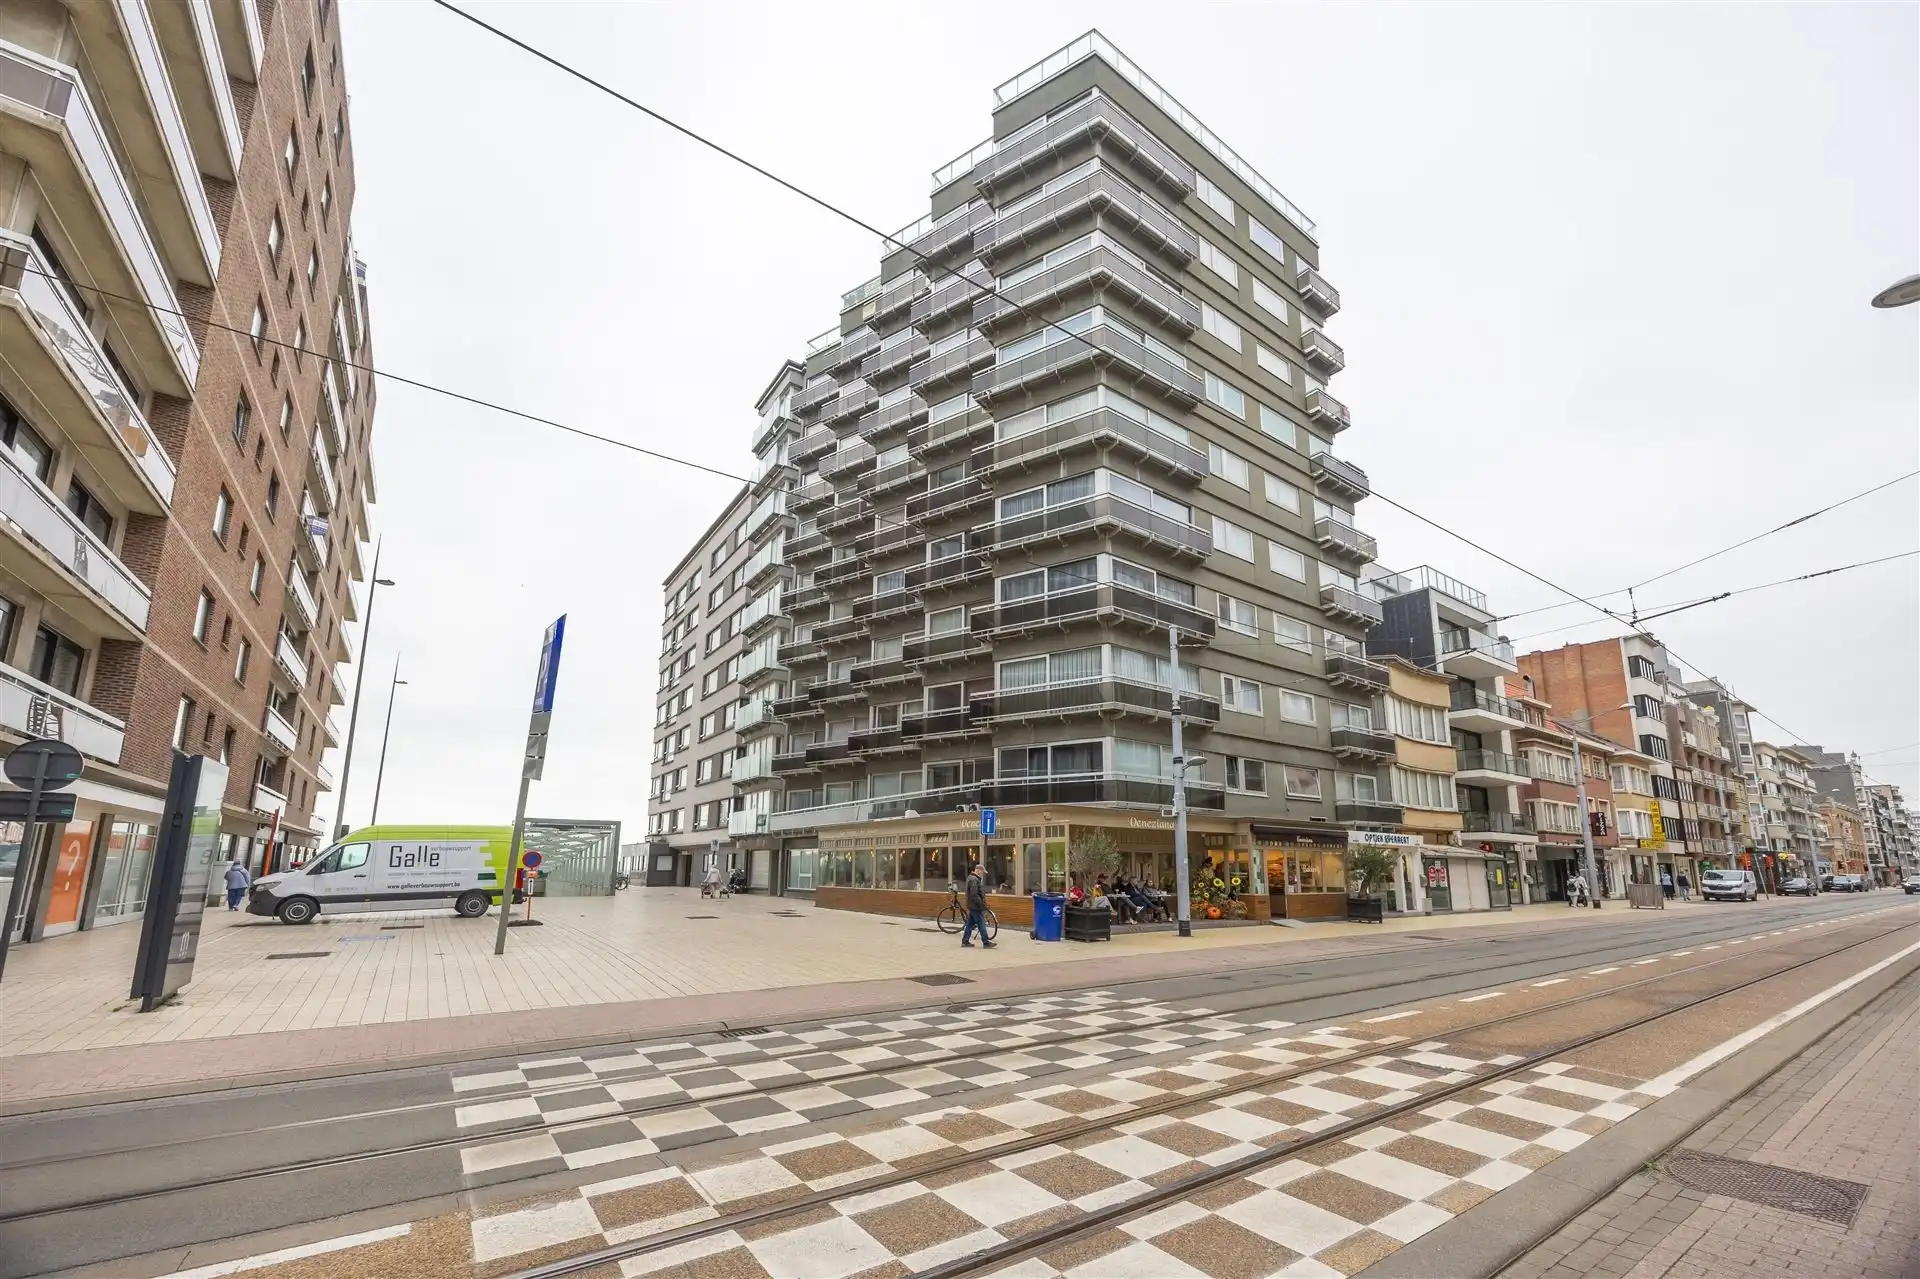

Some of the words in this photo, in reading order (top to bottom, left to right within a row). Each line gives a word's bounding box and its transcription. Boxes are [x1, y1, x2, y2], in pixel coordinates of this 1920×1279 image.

[960, 818, 1001, 828] Venea
[1128, 816, 1175, 829] Veneziana
[389, 845, 440, 867] Galle
